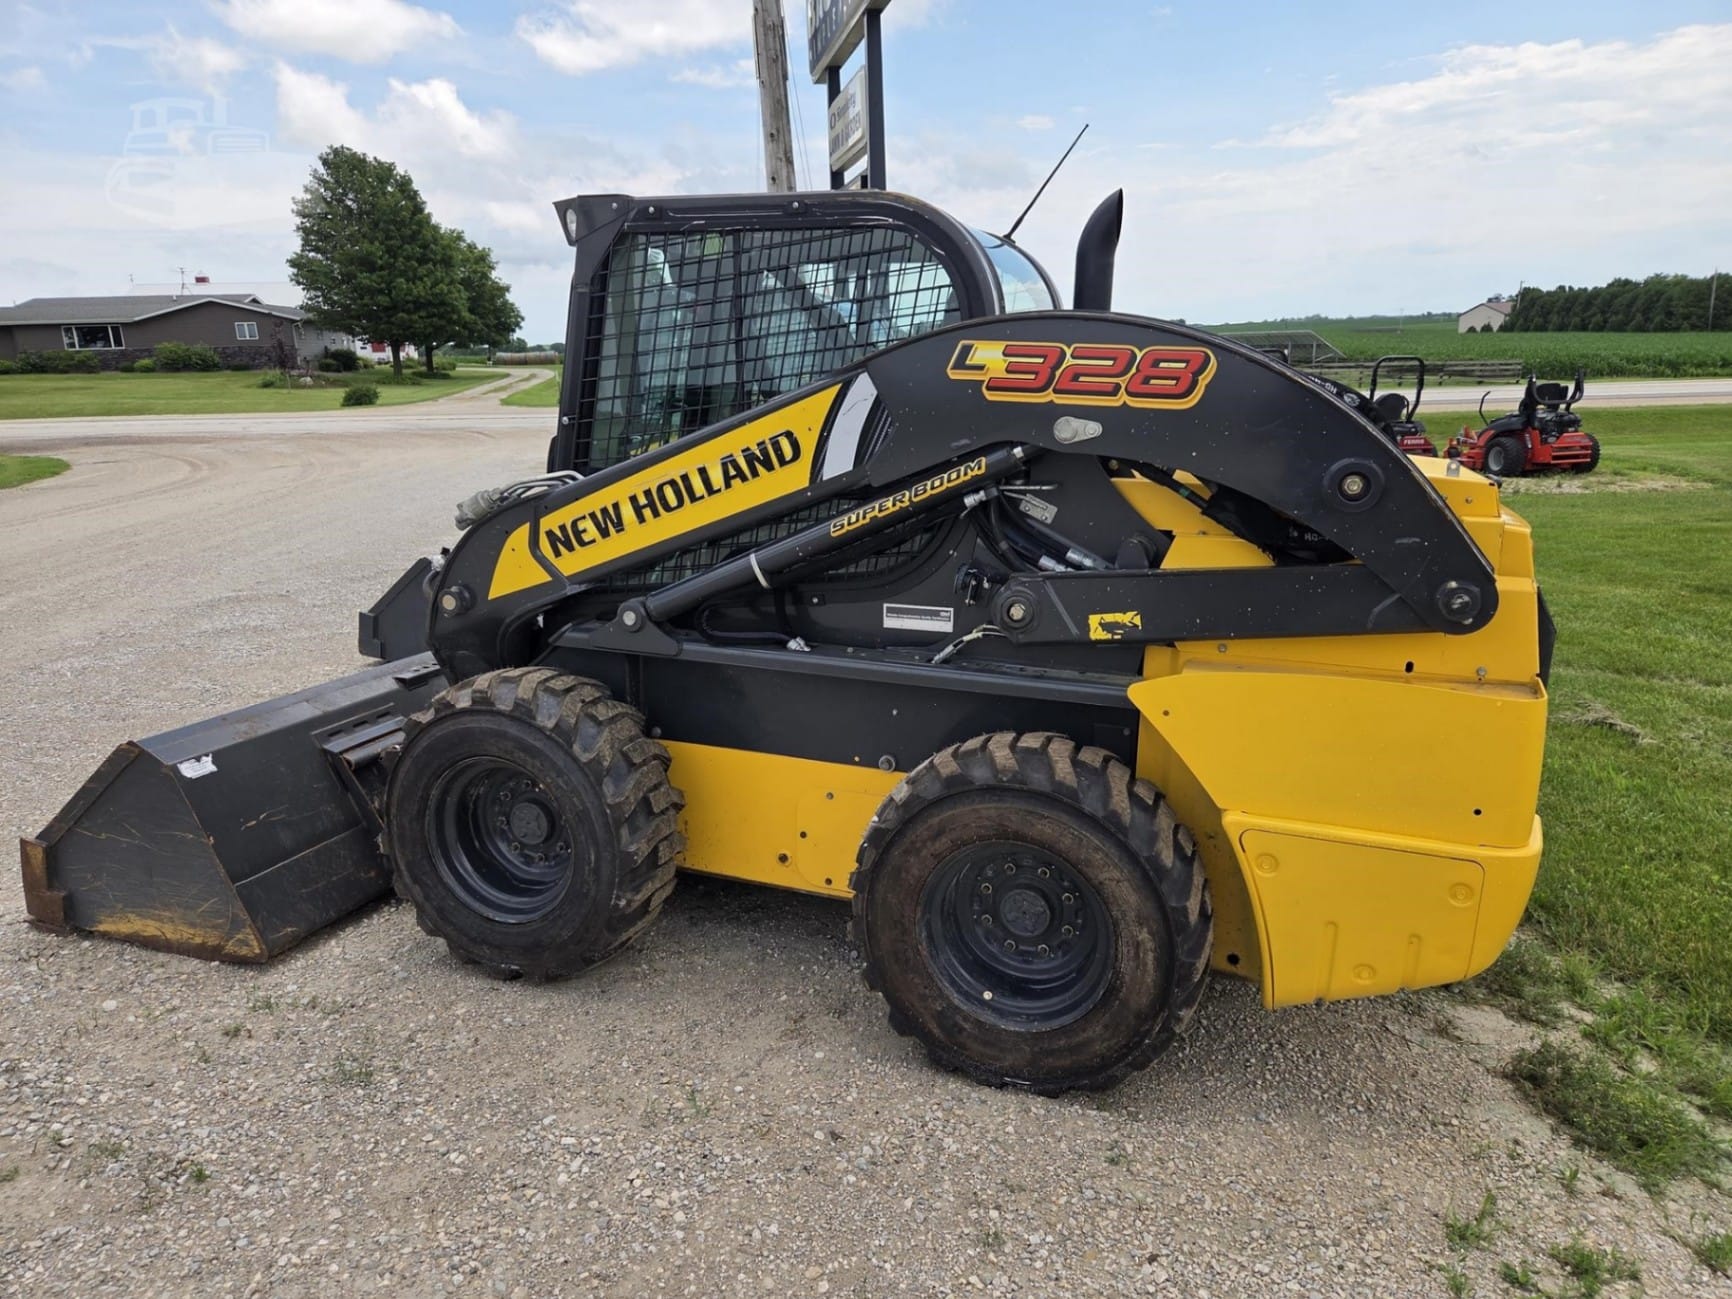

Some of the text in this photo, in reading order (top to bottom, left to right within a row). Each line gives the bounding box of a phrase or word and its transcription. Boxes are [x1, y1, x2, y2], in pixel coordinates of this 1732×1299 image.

[544, 429, 802, 559] NEW HOLLAND
[831, 456, 987, 537] SUPER BOOM
